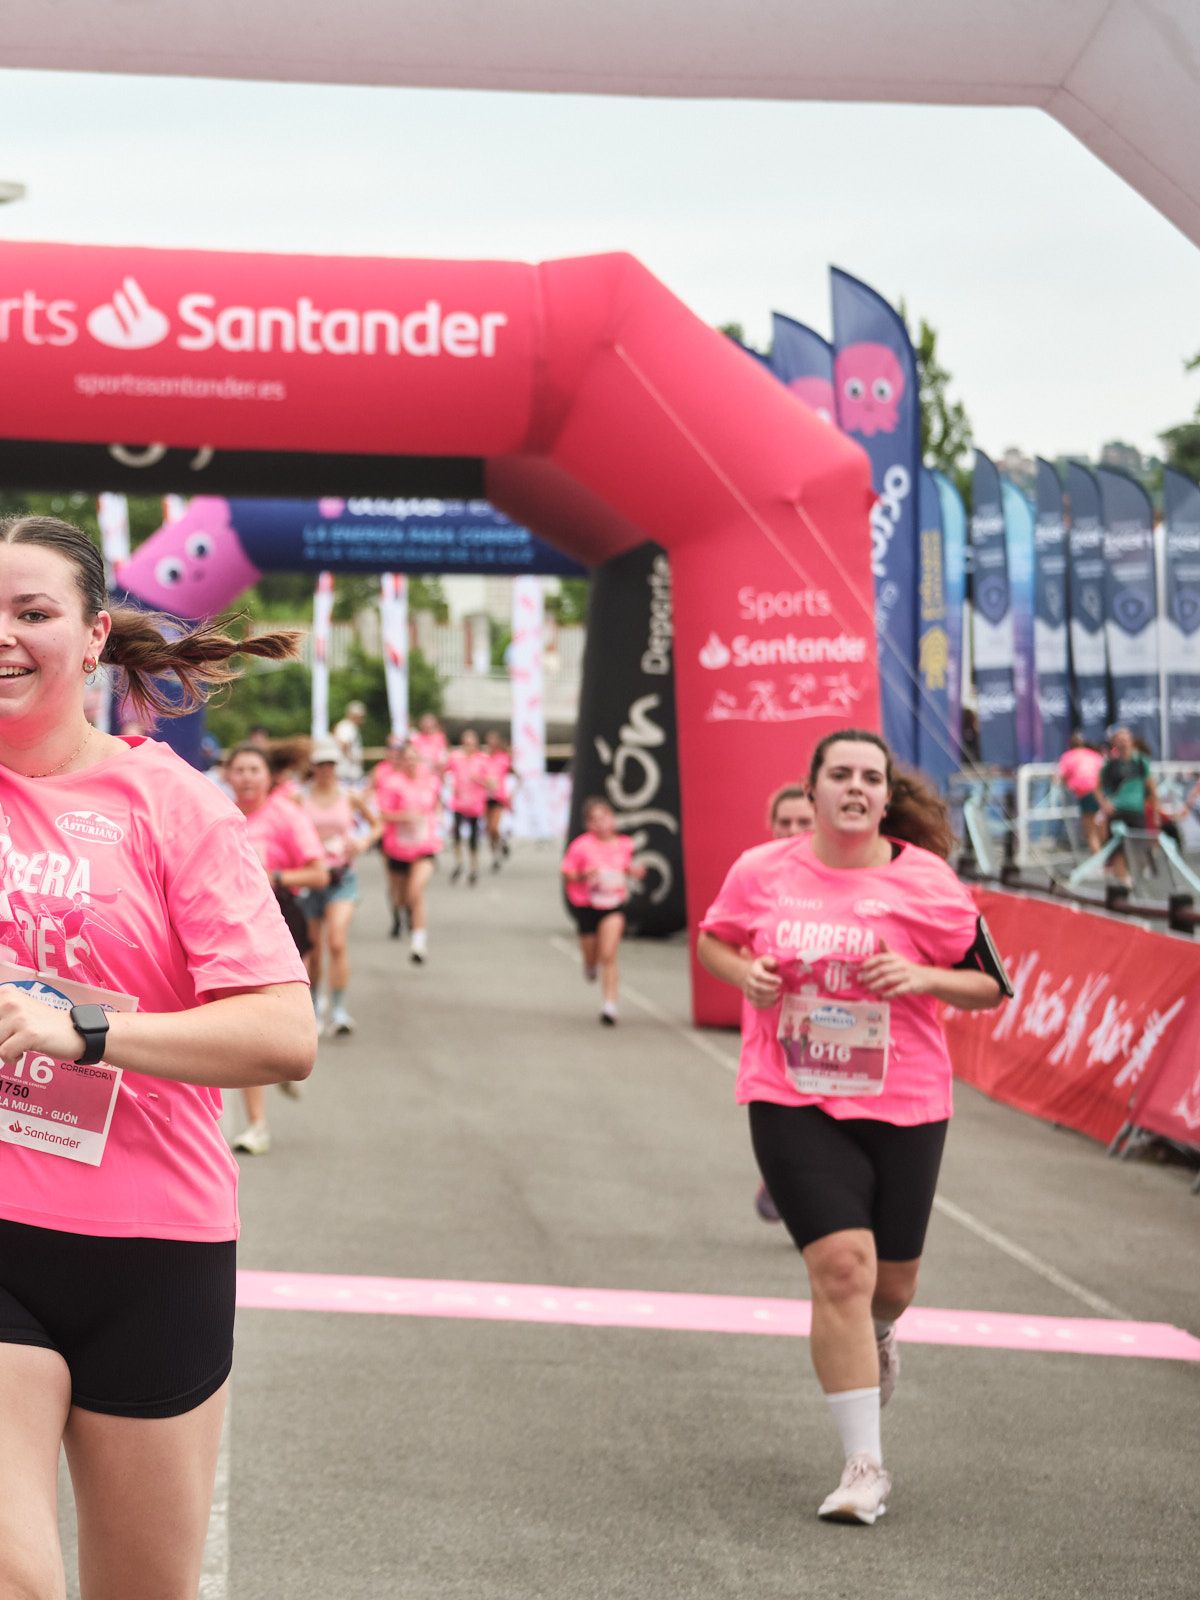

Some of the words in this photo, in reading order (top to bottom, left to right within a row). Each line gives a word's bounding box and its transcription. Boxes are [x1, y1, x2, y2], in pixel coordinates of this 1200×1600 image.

[176, 294, 507, 358] Santander
[738, 586, 831, 624] Sports
[731, 632, 866, 667] Santander
[776, 919, 875, 956] CARRERA
[809, 1041, 852, 1063] 016
[60, 1062, 112, 1081] CORREDORA
[11, 1101, 43, 1116] MUJER
[51, 1109, 78, 1125] GIJÓN
[24, 1125, 81, 1150] Santander
